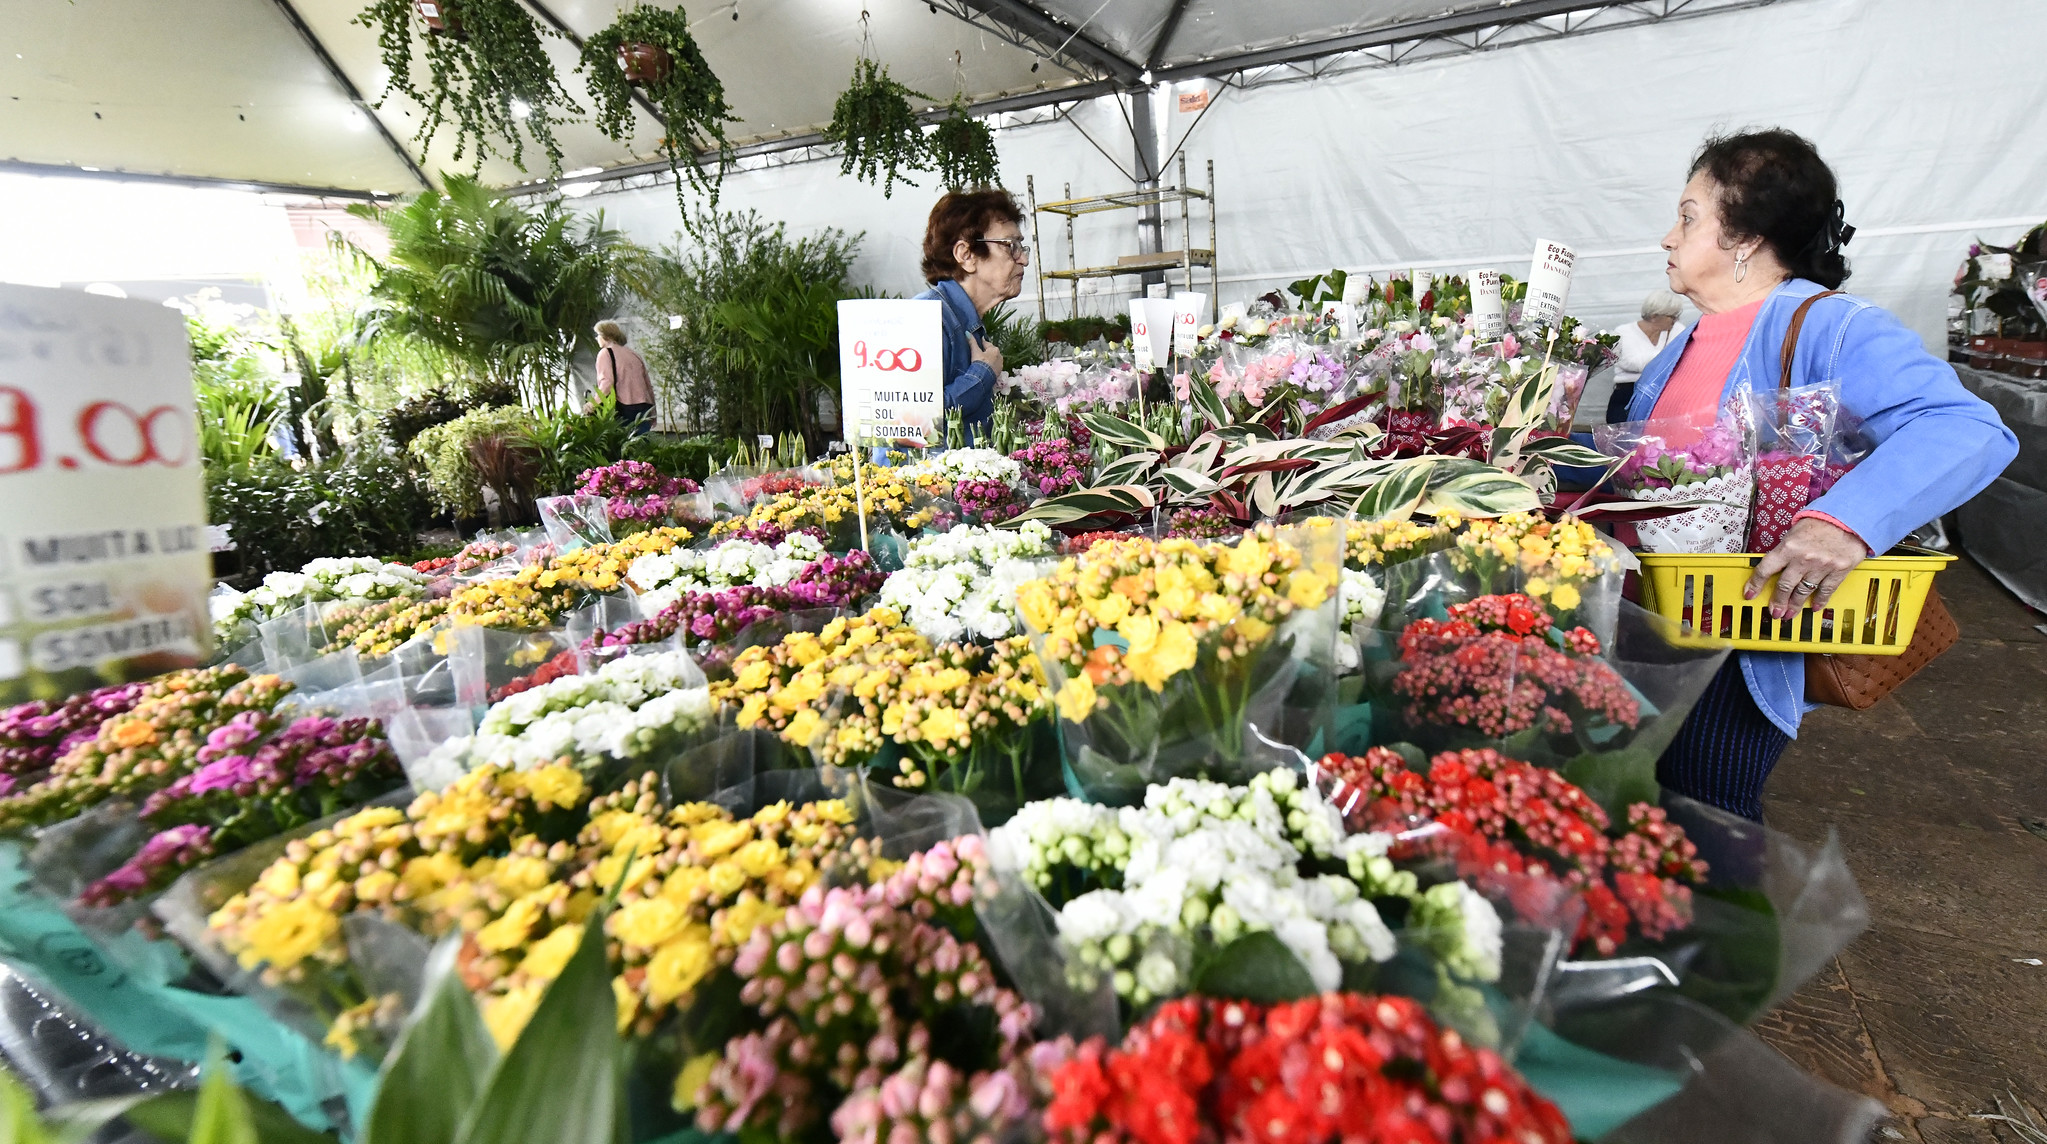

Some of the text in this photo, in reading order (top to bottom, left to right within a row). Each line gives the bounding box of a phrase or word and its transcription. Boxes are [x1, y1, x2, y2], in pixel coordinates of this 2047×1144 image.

[854, 340, 922, 373] 9.00
[874, 391, 934, 403] MUITA LUZ
[875, 408, 894, 420] SOL
[875, 425, 923, 438] SOMBRA
[32, 582, 110, 616] SOL
